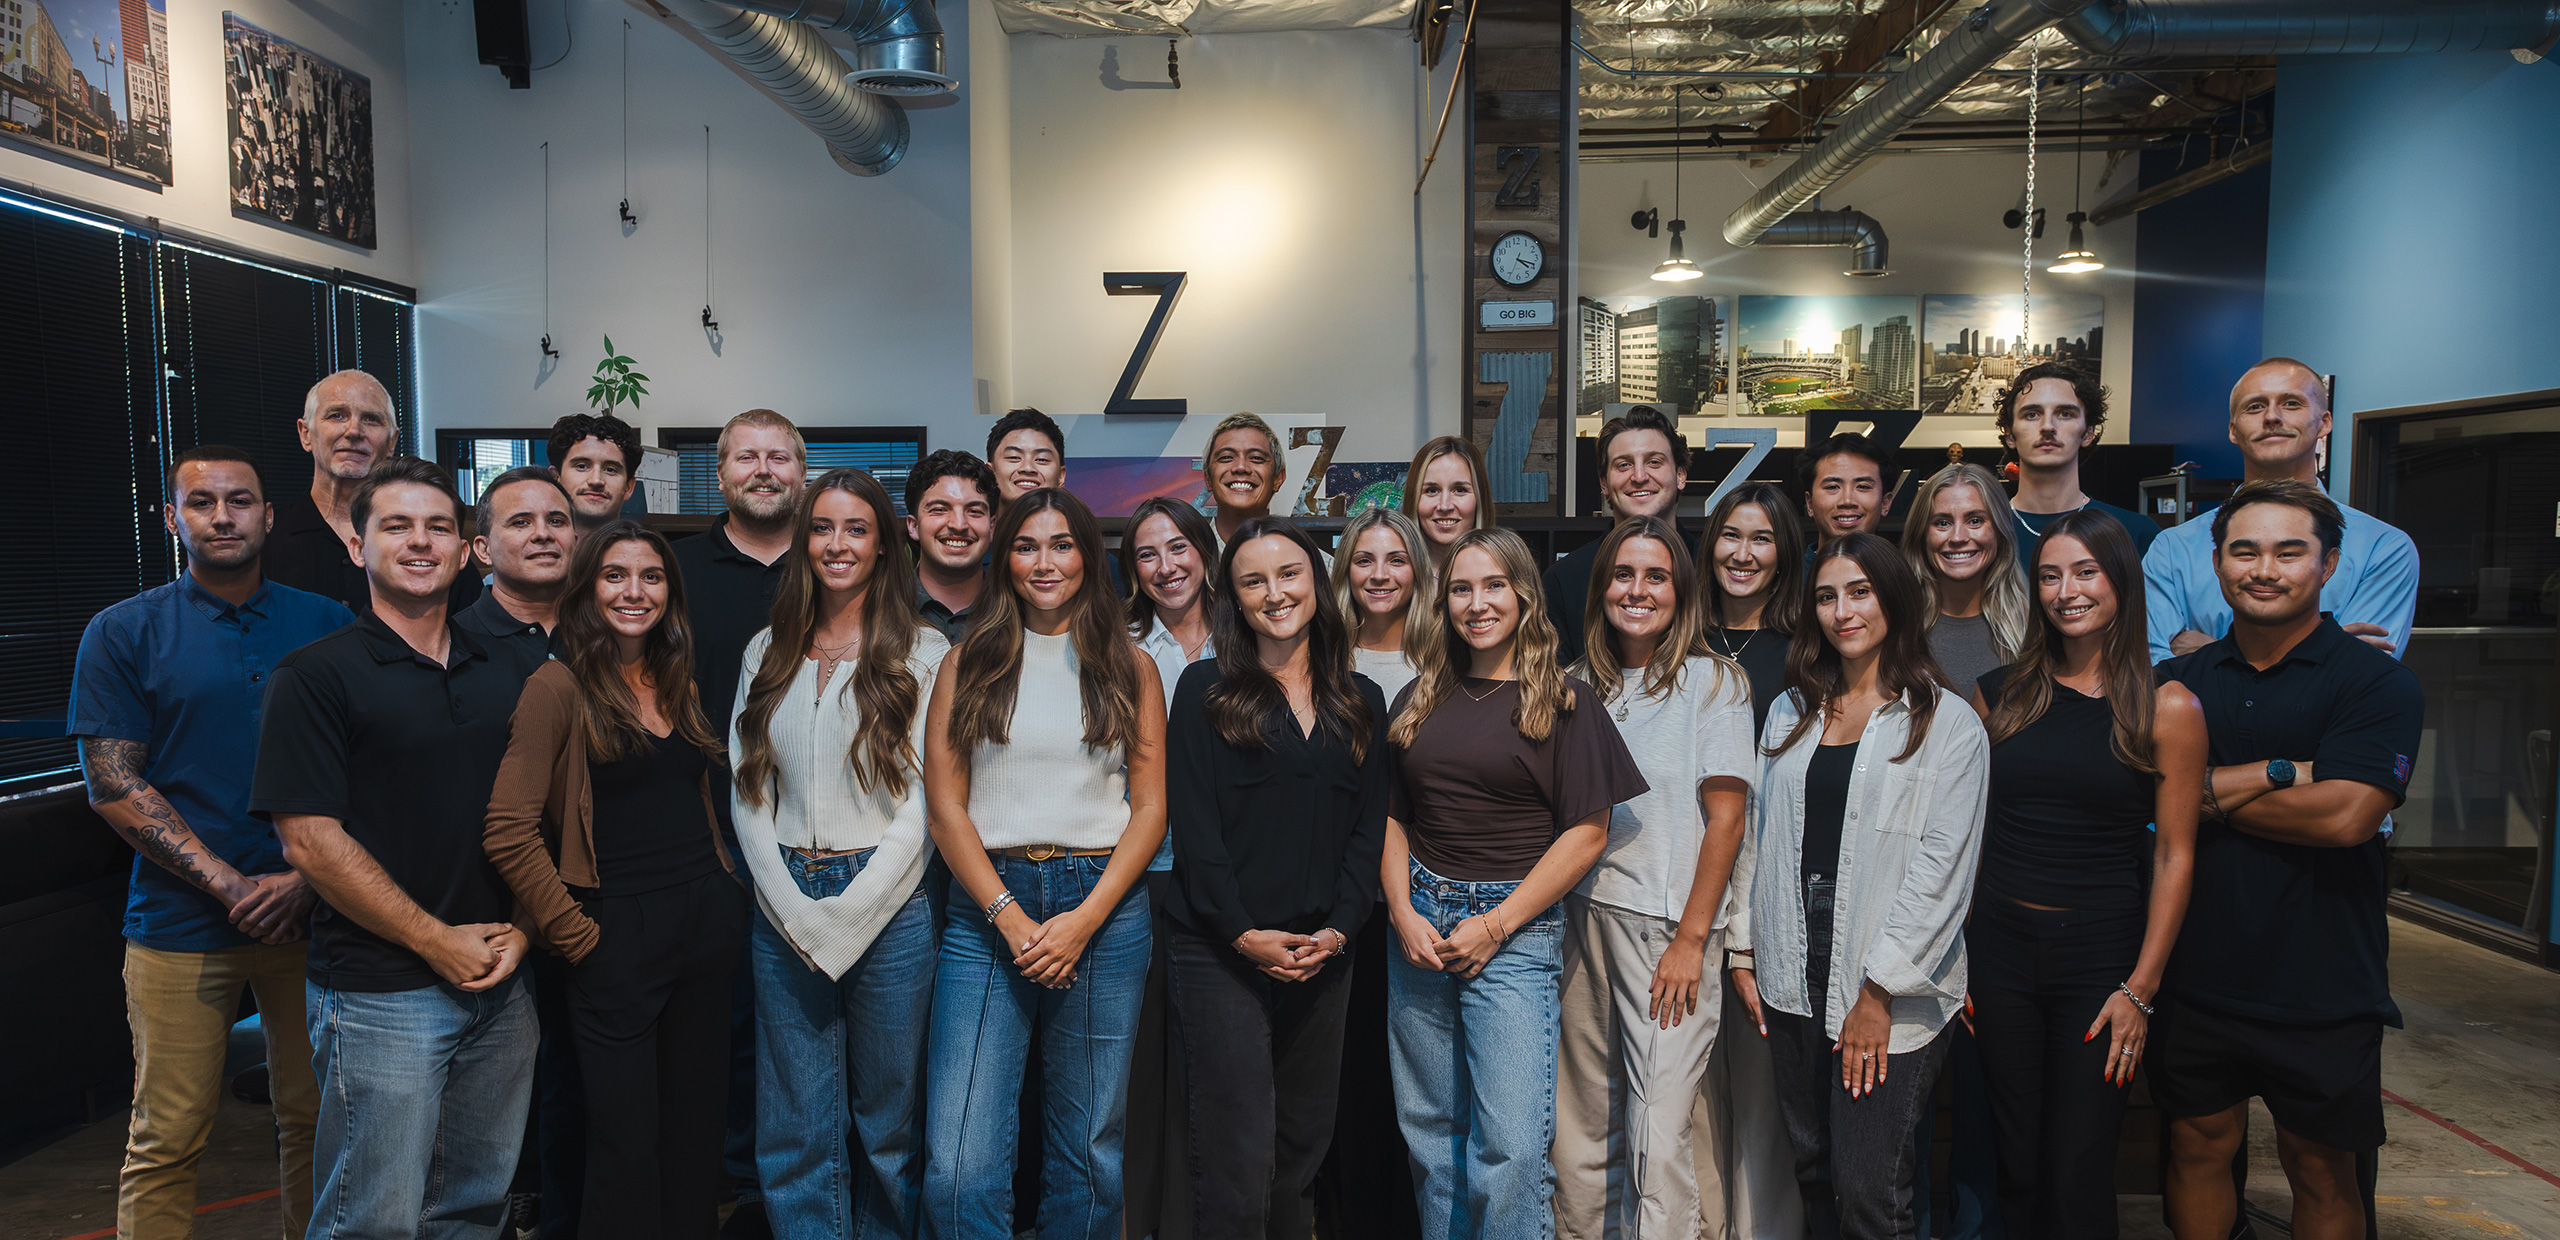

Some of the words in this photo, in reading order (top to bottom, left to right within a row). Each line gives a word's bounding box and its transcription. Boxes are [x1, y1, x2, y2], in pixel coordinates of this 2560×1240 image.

[1495, 147, 1539, 206] Z
[1505, 240, 1511, 248] 11
[1512, 237, 1520, 245] 12
[1498, 247, 1506, 255] 10
[1530, 245, 1536, 253] 2
[1496, 256, 1501, 264] 9
[1534, 254, 1539, 262] 3
[1499, 265, 1505, 273] 8
[1507, 271, 1512, 279] 7
[1516, 272, 1521, 280] 6
[1524, 270, 1530, 278] 5
[1499, 310, 1516, 319] GO
[1518, 309, 1536, 319] BIG
[1103, 271, 1188, 414] Z
[1480, 352, 1552, 503] Z
[1289, 426, 1346, 517] Z
